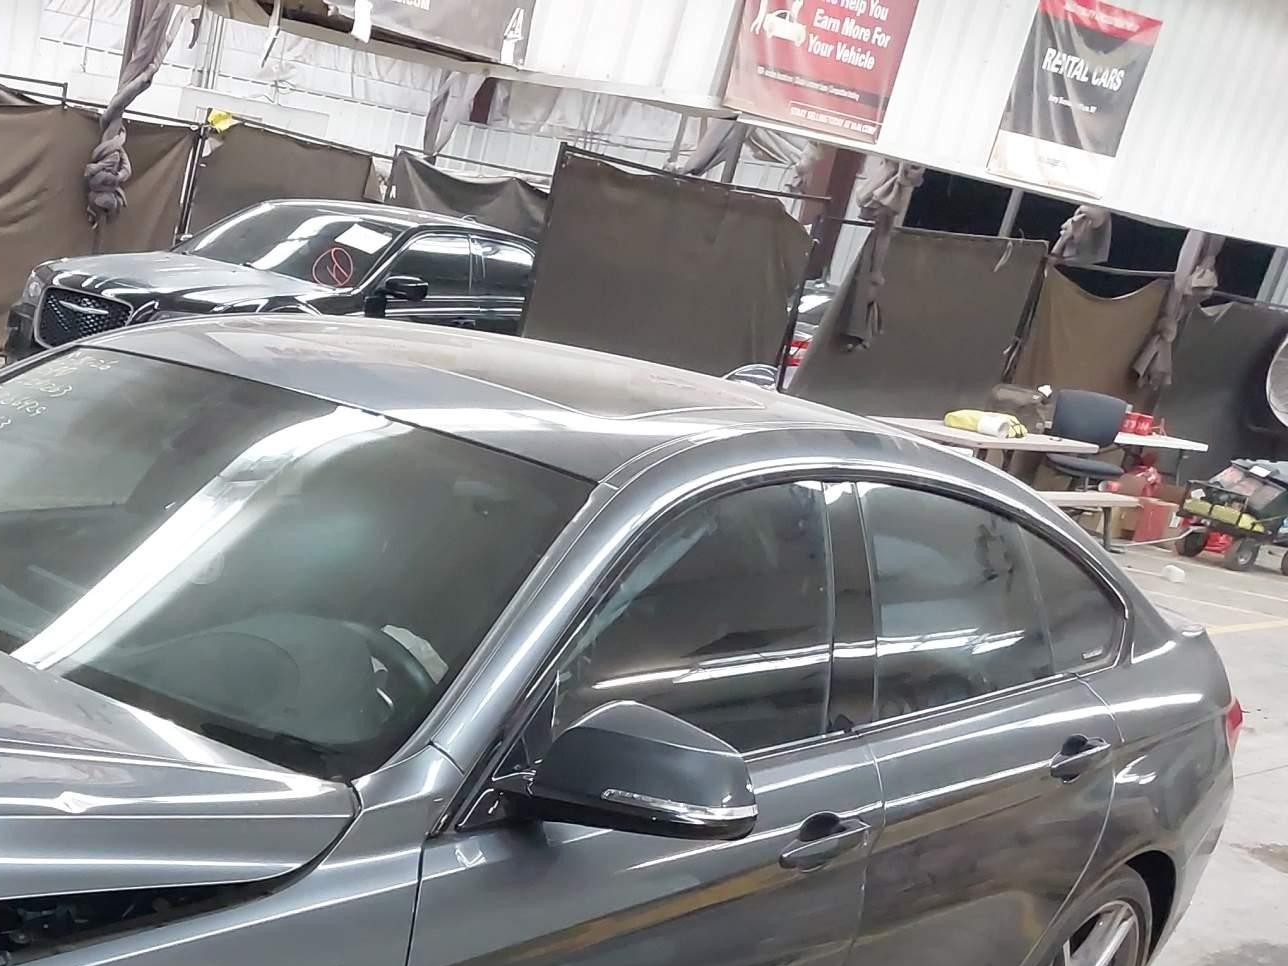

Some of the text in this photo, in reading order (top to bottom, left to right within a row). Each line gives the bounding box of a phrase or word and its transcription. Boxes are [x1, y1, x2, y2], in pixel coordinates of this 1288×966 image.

[813, 8, 891, 48] Earn More For
[869, 0, 889, 20] You
[808, 34, 875, 70] Your Vehicle
[1042, 47, 1125, 91] RENTAL CARS
